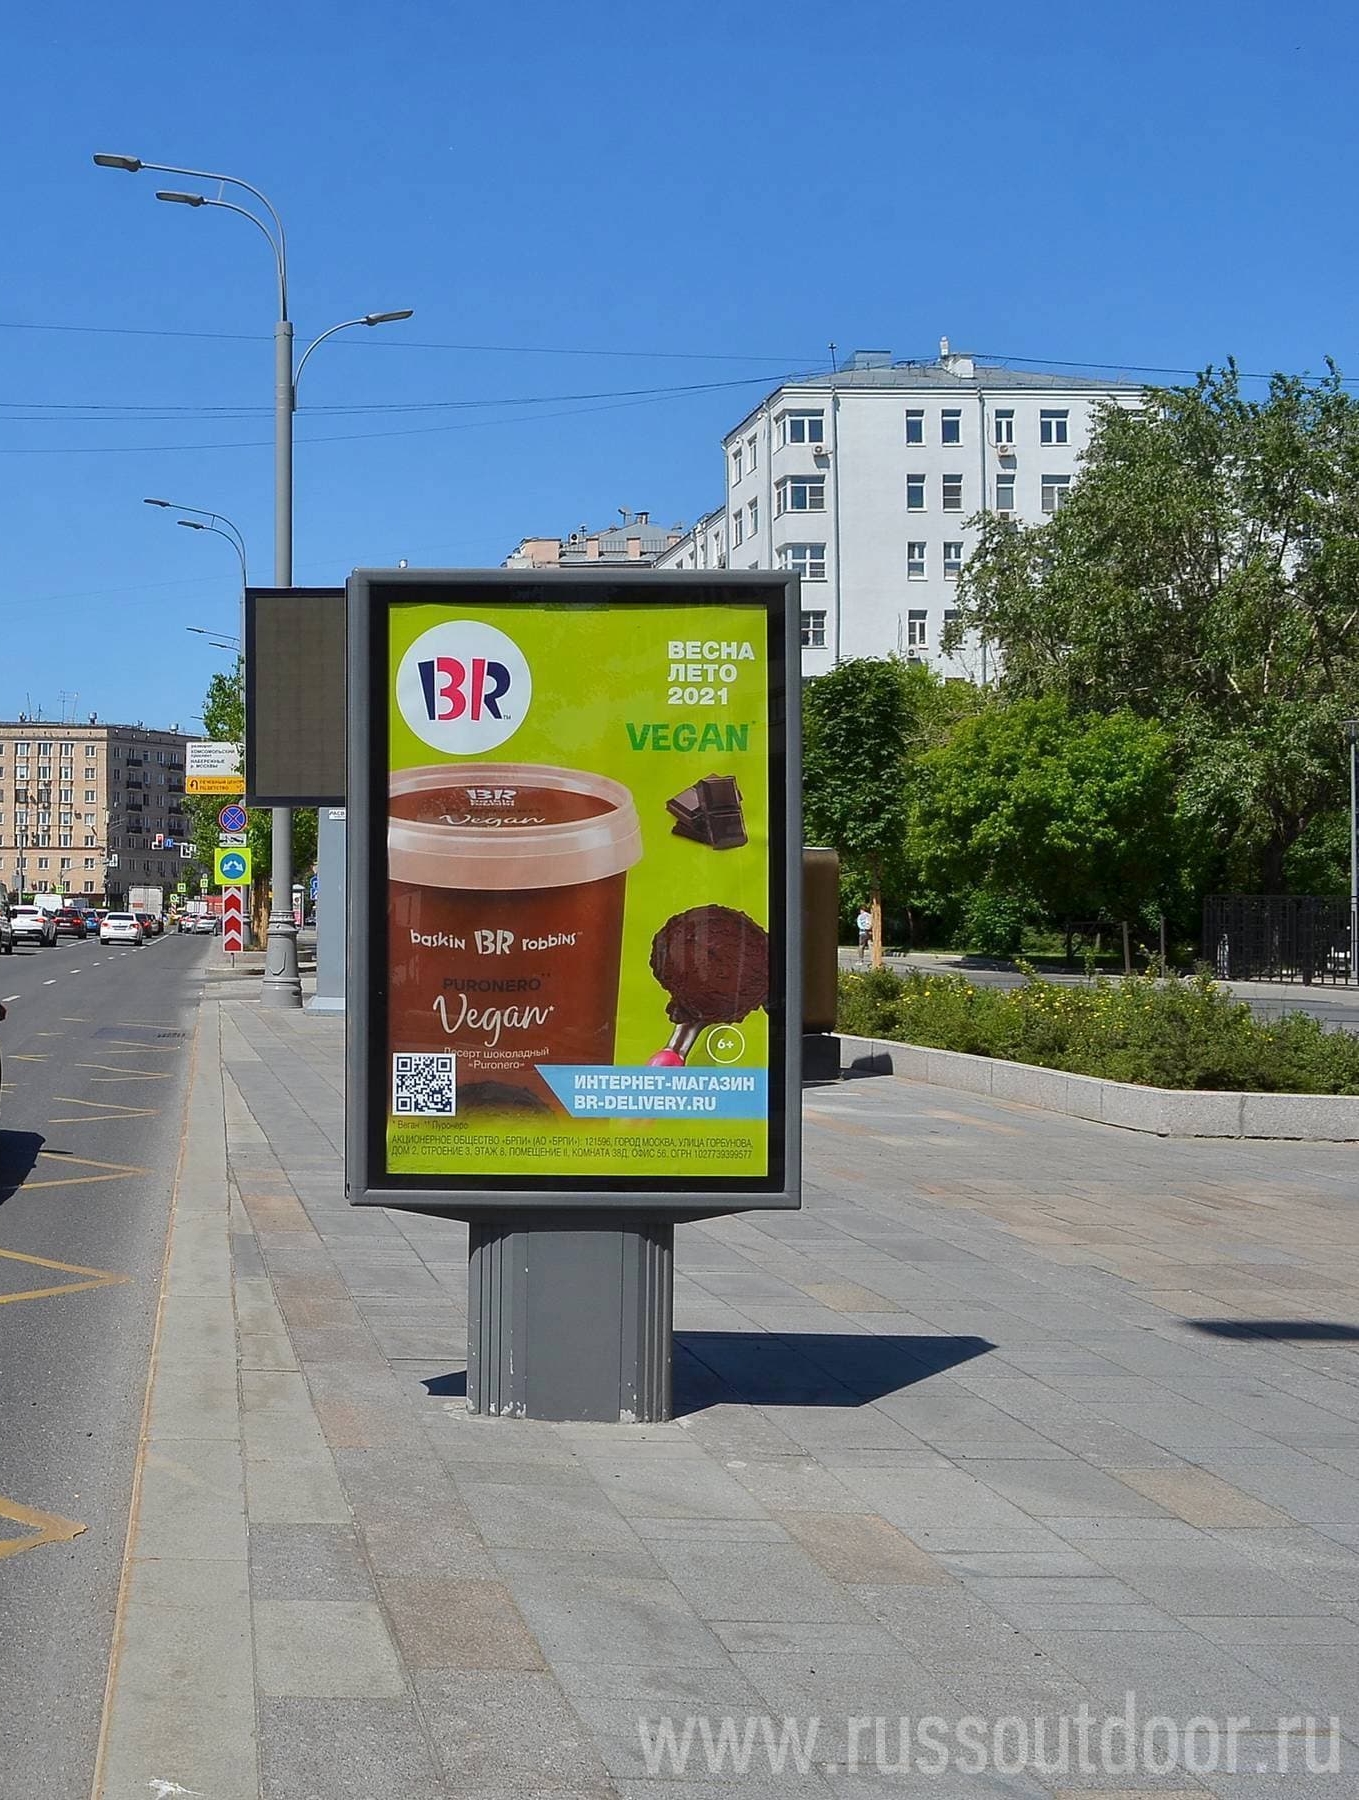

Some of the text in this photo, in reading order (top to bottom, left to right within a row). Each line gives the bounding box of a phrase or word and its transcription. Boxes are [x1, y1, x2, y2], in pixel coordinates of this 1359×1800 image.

[668, 641, 755, 660] ВЕСНА
[667, 664, 738, 682] ЛЕТО
[417, 656, 511, 721] BR
[668, 687, 728, 705] 2021
[466, 789, 517, 801] BR
[439, 814, 546, 828] Vegan
[410, 929, 577, 955] baskin BR robbins
[717, 1038, 734, 1049] 6+
[483, 1046, 549, 1059] шоколадный
[575, 1075, 755, 1091] ИНТЕРНЕТ-МАГАЗИН
[575, 1096, 717, 1110] BR-DELIVERY.RU
[392, 1135, 452, 1145] АКЦИОНЕРНОЕ
[453, 1135, 499, 1146] ОБЩЕСТВО
[614, 1137, 640, 1148] ГОРОД
[678, 1138, 705, 1149] УЛИЦА
[392, 1146, 409, 1156] ДОМ
[421, 1146, 464, 1155] СТРОЕНИЕ
[474, 1147, 498, 1156] ЭТАЖ
[509, 1147, 561, 1157] ПОМЕЩЕНИЕ
[572, 1148, 610, 1157] КОМНАТА
[632, 1149, 655, 1158] ОФИС
[670, 1149, 692, 1158] ОГРН
